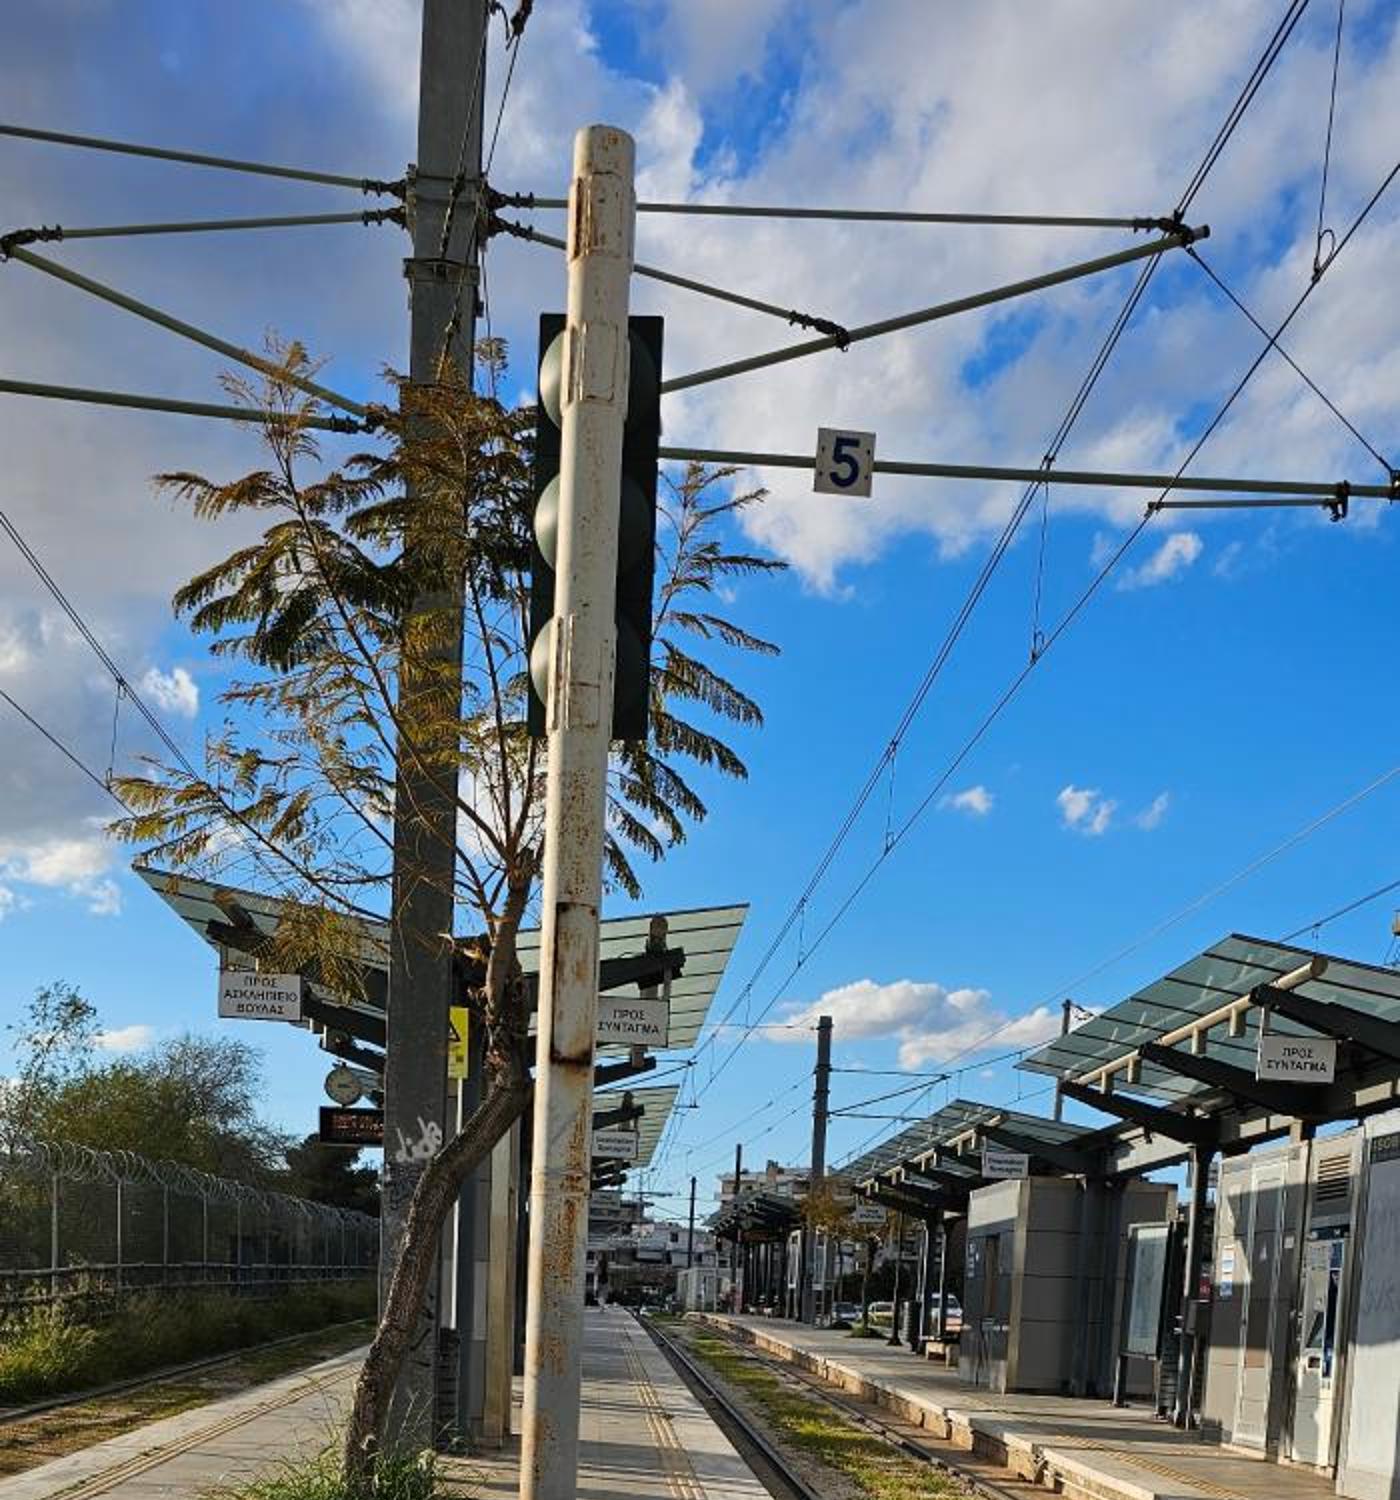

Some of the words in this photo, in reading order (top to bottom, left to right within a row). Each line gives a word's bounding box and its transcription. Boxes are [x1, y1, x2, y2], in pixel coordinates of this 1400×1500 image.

[830, 437, 861, 488] 5
[237, 1003, 284, 1015] ΒΟΥΛΑΣ
[613, 1009, 645, 1020] ΠΡΟΣ
[598, 1021, 659, 1034] ΣΥΝΤΑΓΜΑ
[1282, 1048, 1314, 1058] ΠΡΟΣ
[1267, 1060, 1327, 1073] ΣΥΝΤΑΓΜΑ
